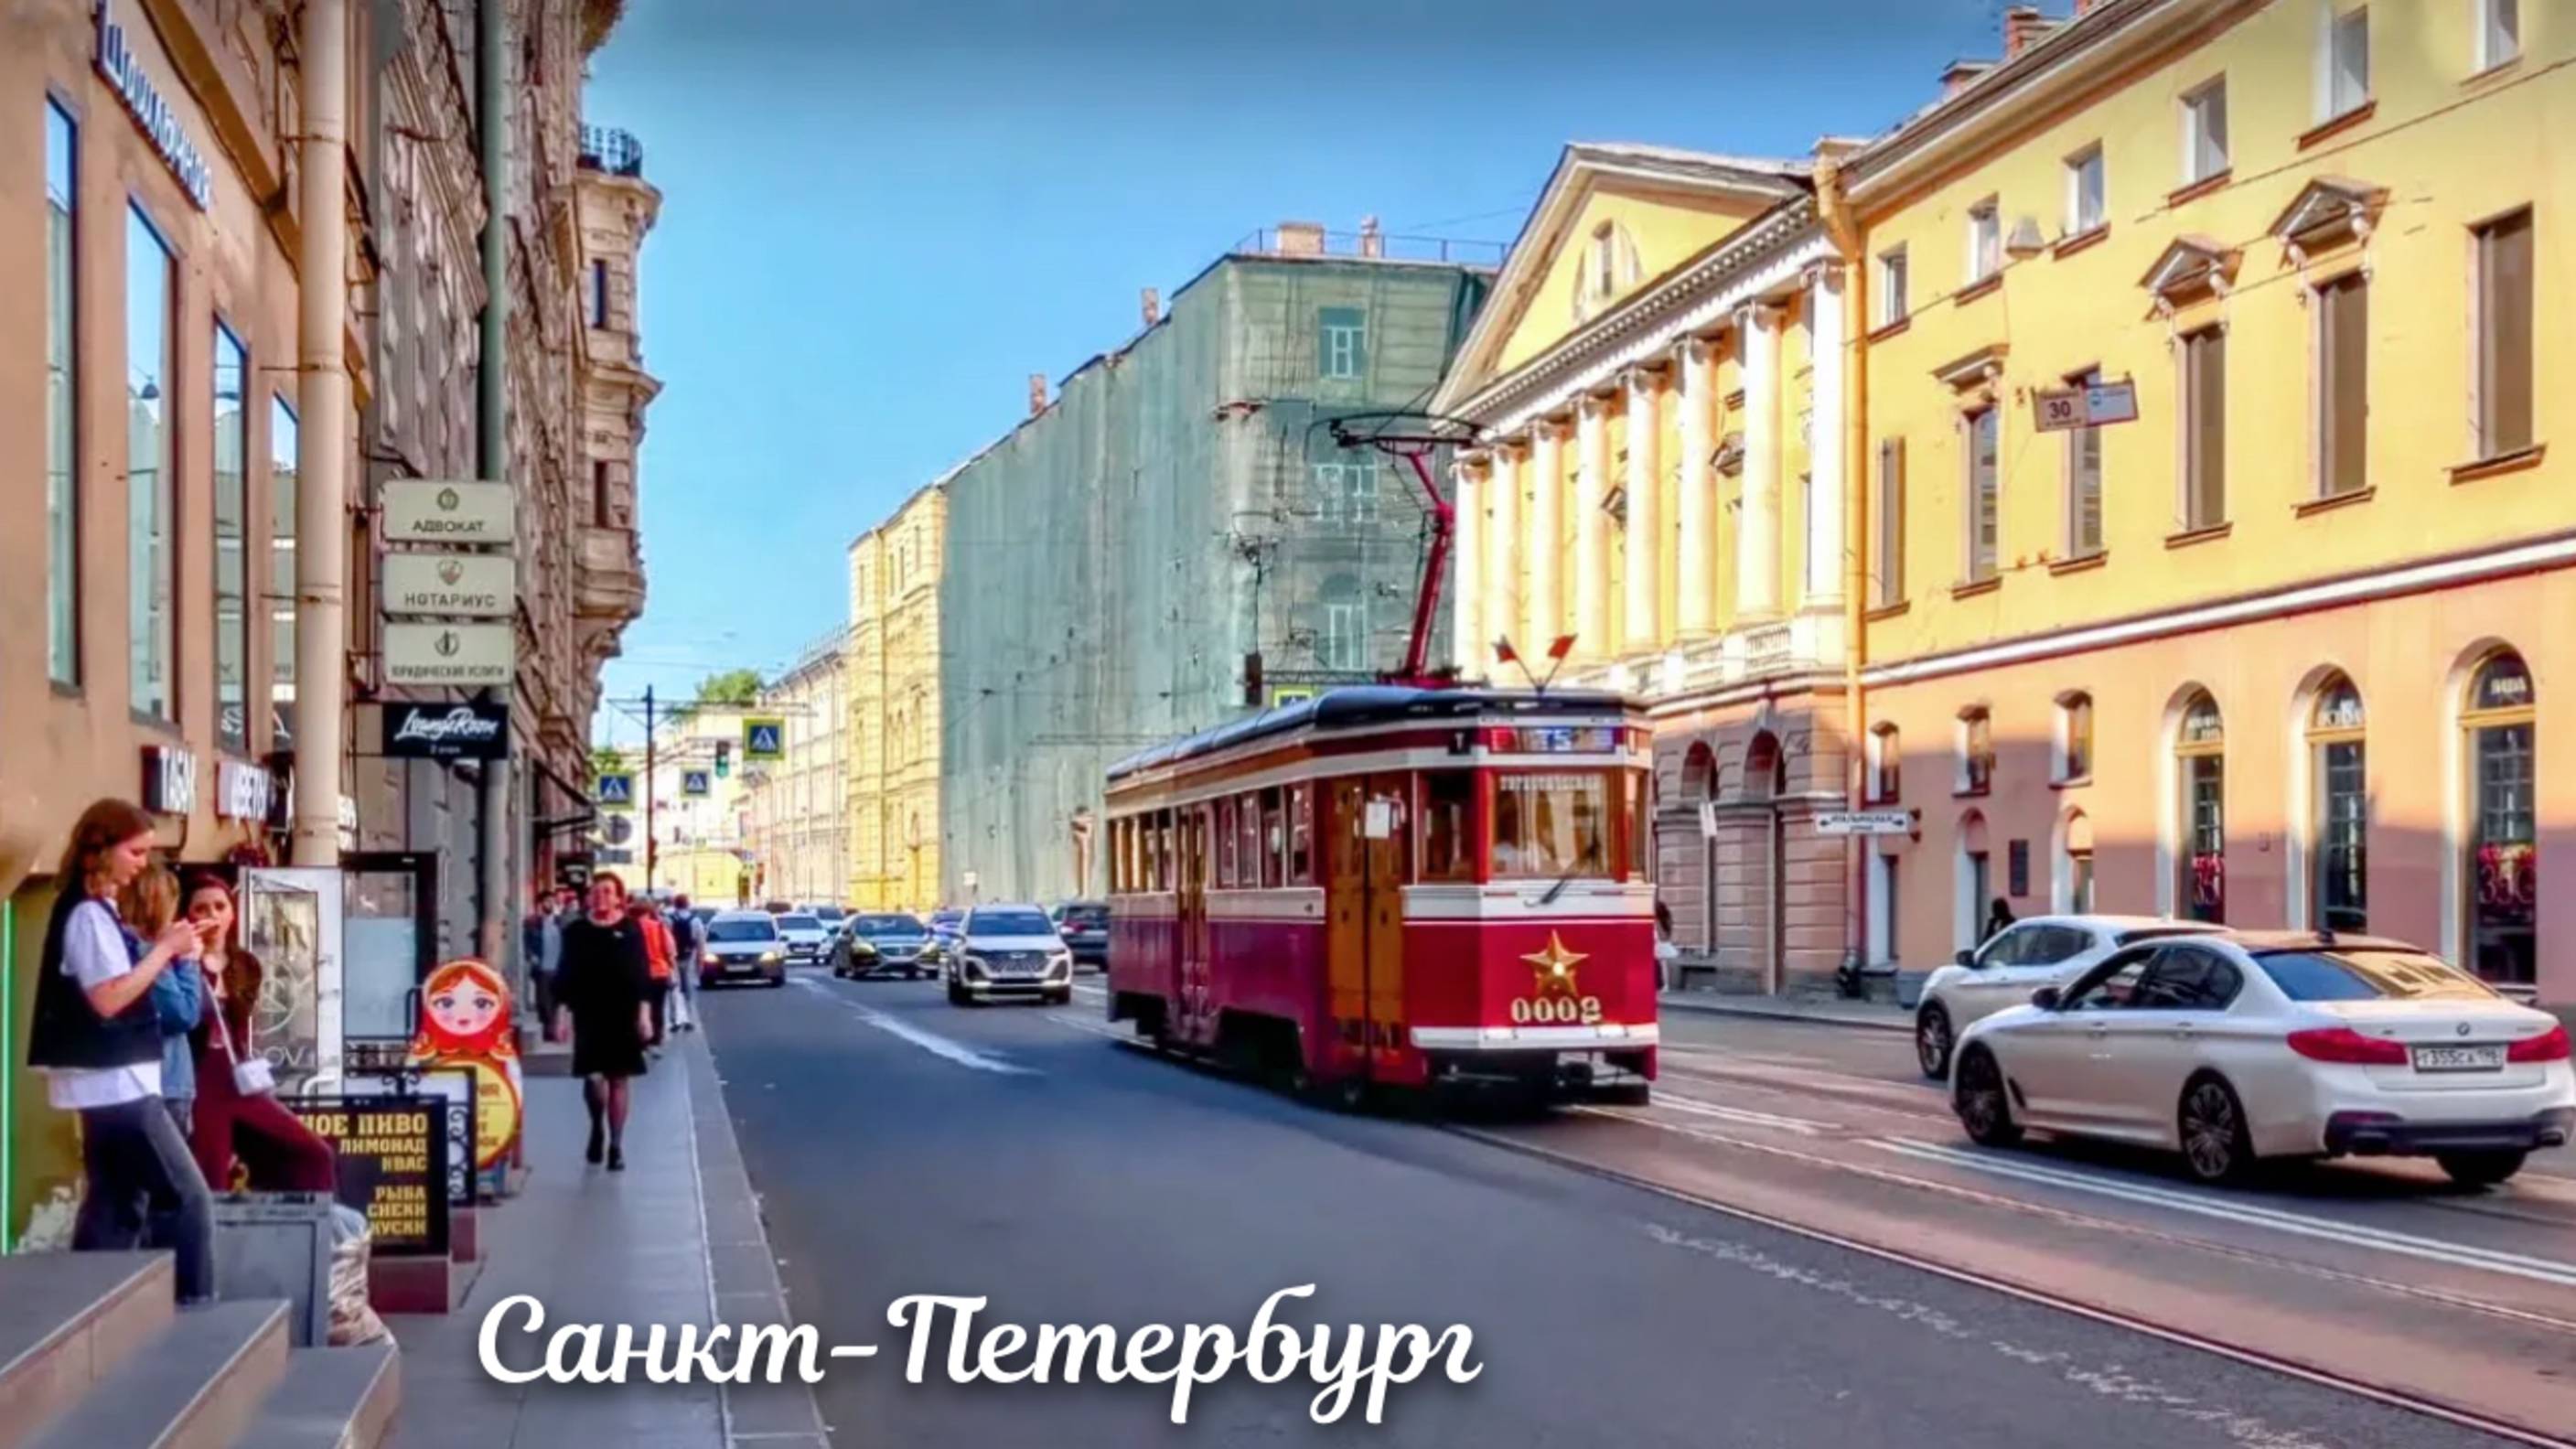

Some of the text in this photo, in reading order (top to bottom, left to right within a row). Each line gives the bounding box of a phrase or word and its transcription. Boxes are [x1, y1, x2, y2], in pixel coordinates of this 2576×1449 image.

[413, 520, 484, 532] АДВОКАТ
[405, 593, 496, 606] НОТАРИУС
[392, 665, 465, 678] ЮРИДИЧЕСКИЕ
[1510, 994, 1603, 1025] 0002
[357, 1112, 428, 1136] ПИВО
[339, 1138, 427, 1154] ЛИМОНАД
[381, 1156, 427, 1172] КВАС
[374, 1185, 426, 1201] РЫБА
[366, 1202, 426, 1218] СНЕКИ
